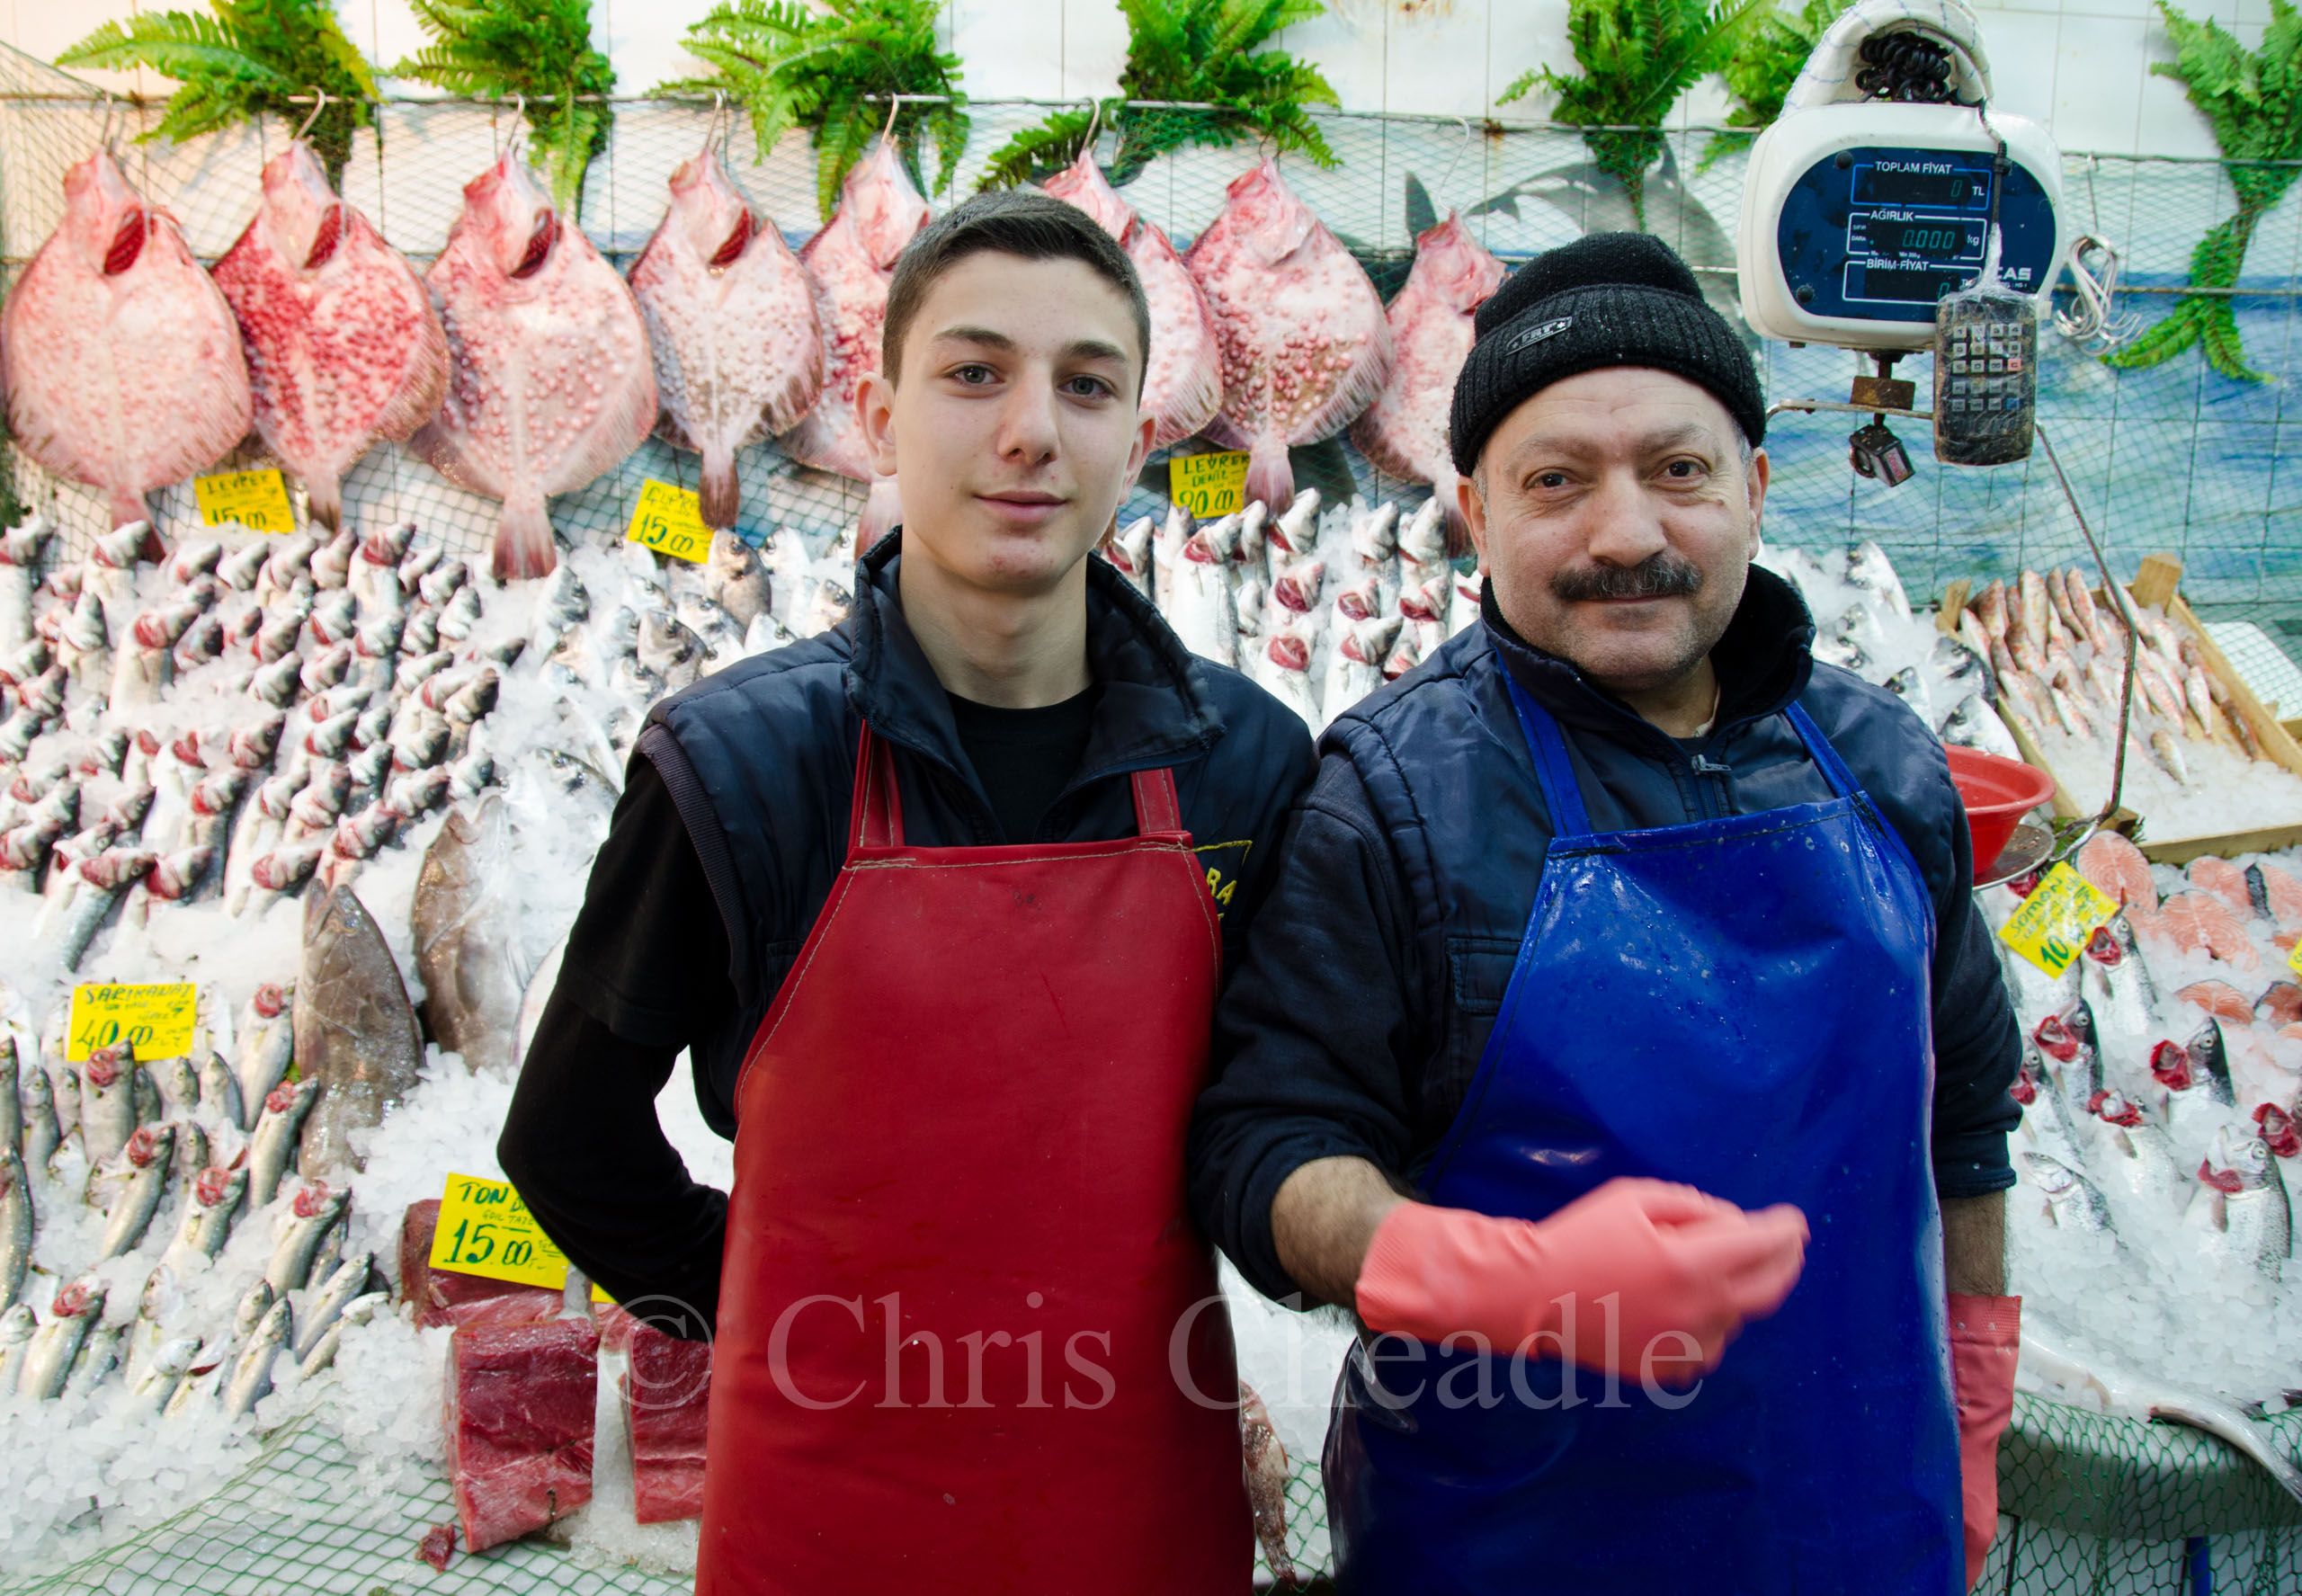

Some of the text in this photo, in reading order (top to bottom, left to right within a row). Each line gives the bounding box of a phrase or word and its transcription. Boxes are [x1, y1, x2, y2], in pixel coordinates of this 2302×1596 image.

[1875, 161, 1952, 174] TOPLAM FİYAT
[1950, 179, 1963, 197] 0
[1972, 186, 1985, 196] TL
[1870, 209, 1914, 221] AĞIRLIK
[1967, 235, 1979, 245] kg
[2040, 935, 2069, 968] 10
[459, 1181, 509, 1204] TON
